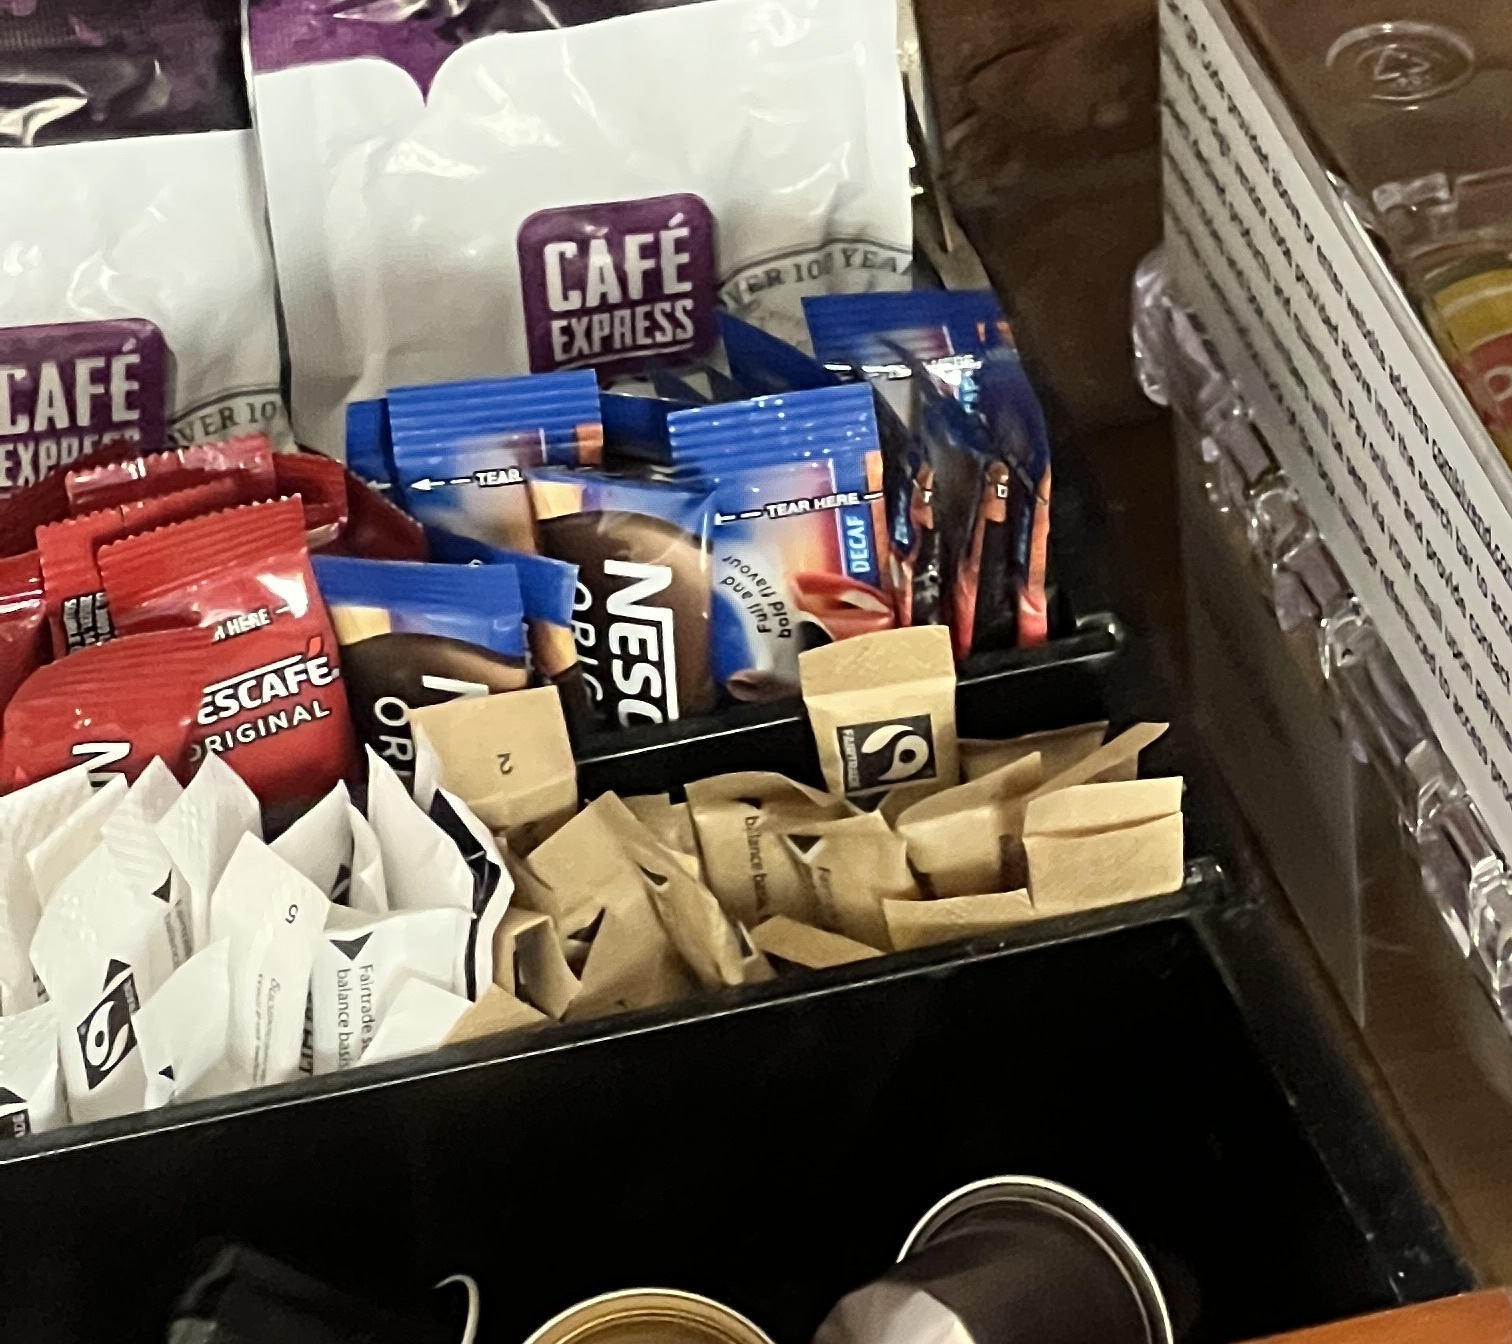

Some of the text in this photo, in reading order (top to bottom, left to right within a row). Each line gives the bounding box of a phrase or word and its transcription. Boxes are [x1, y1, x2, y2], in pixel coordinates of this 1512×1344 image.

[544, 213, 692, 311] CAFÉ
[720, 267, 785, 311] VER
[550, 299, 694, 362] EXPRESS
[0, 338, 140, 436] CAFÉ
[246, 400, 277, 425] 10
[1388, 365, 1429, 444] address
[476, 468, 523, 488] TEAR
[766, 492, 860, 519] TEAR HERE
[845, 514, 871, 574] DECAF
[1397, 432, 1415, 476] the
[1418, 470, 1452, 538] search
[1455, 527, 1473, 571] bar
[1476, 564, 1487, 598] to
[227, 607, 272, 638] HERE
[721, 575, 772, 634] Full and
[722, 555, 792, 639] bold flavour
[1403, 500, 1423, 544] and
[1425, 538, 1466, 618] provide
[1469, 613, 1510, 694] contact
[604, 559, 680, 728] NESC
[1444, 626, 1472, 684] upon
[197, 637, 334, 726] ESCAFÉ
[841, 728, 861, 788] FAIRTRADE
[336, 968, 353, 1029] balance
[359, 964, 376, 1033] Fairtrade
